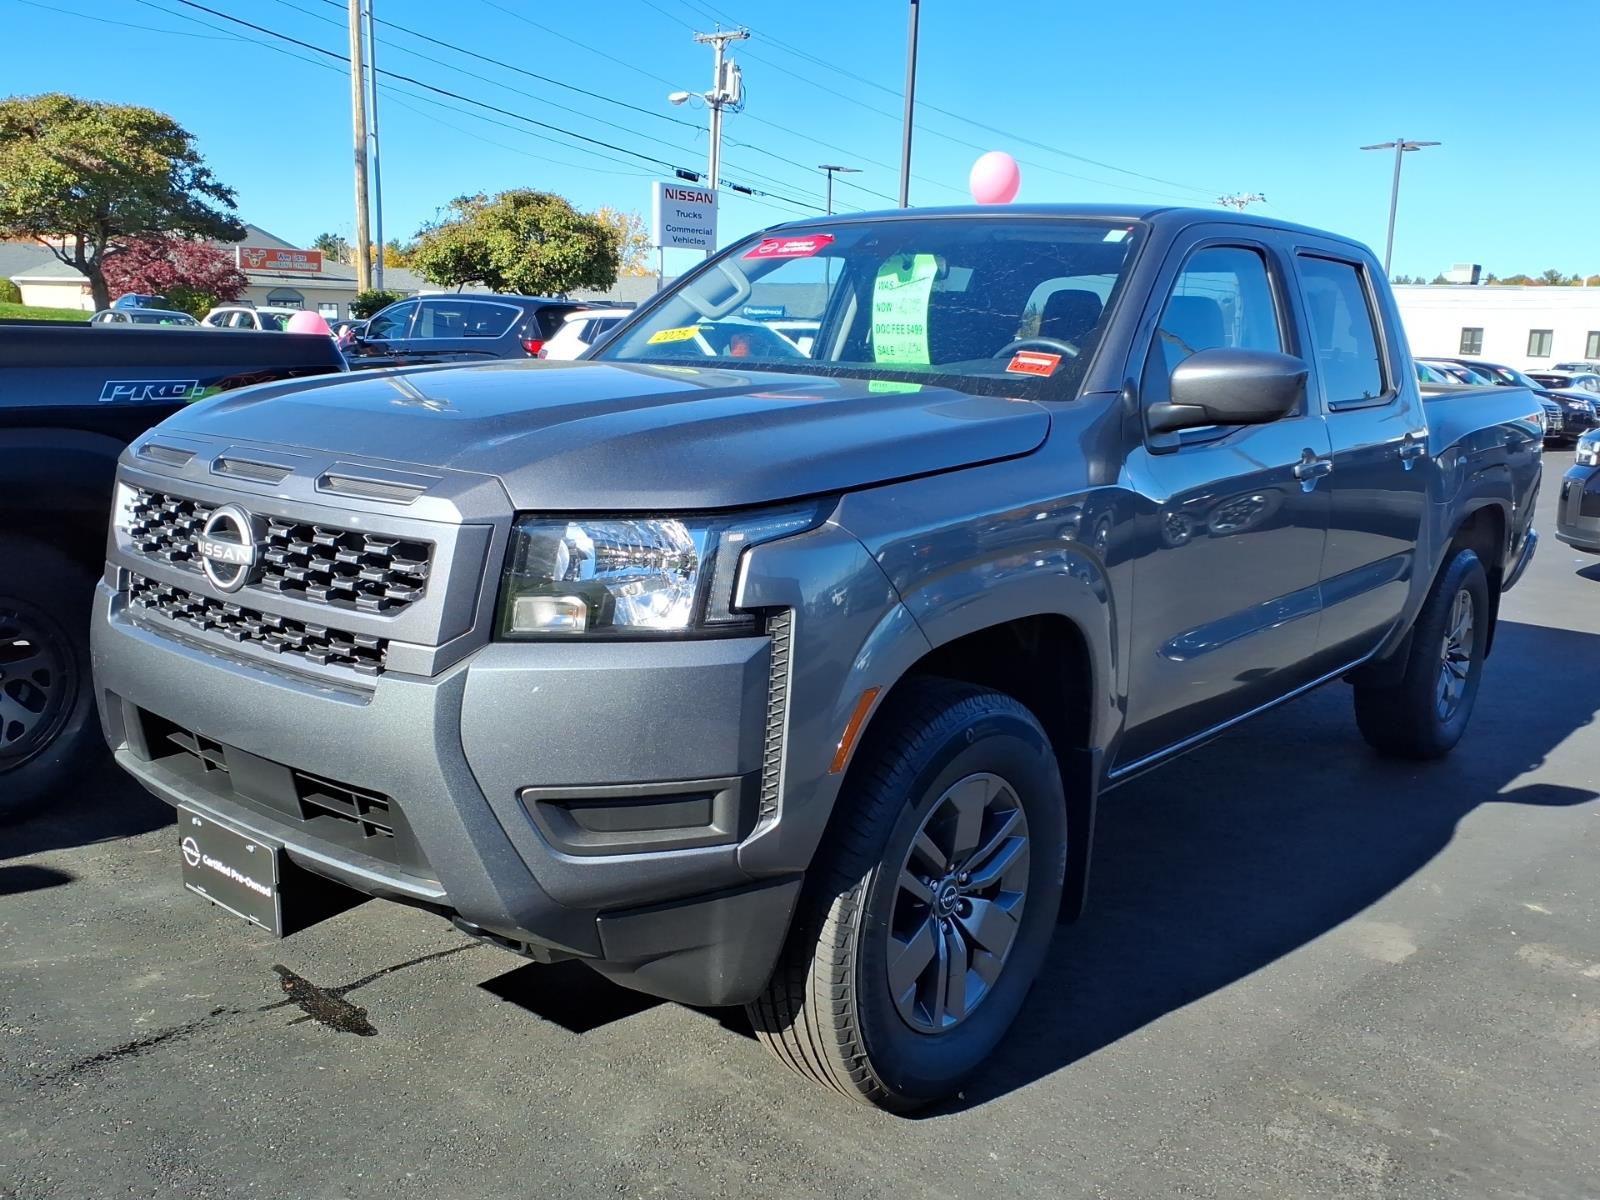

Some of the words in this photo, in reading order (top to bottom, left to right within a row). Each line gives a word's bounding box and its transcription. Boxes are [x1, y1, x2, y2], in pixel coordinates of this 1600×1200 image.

[665, 188, 713, 204] NISSAN
[676, 209, 703, 219] Trucks
[665, 224, 713, 236] Commercial
[672, 235, 706, 246] Vehicles
[876, 302, 892, 312] NOW
[875, 323, 891, 335] DOC
[892, 323, 905, 335] FEE
[877, 345, 895, 356] SALE
[198, 540, 251, 562] NISSAN
[202, 854, 231, 877] Certified
[231, 869, 272, 898] Pre-Owned
